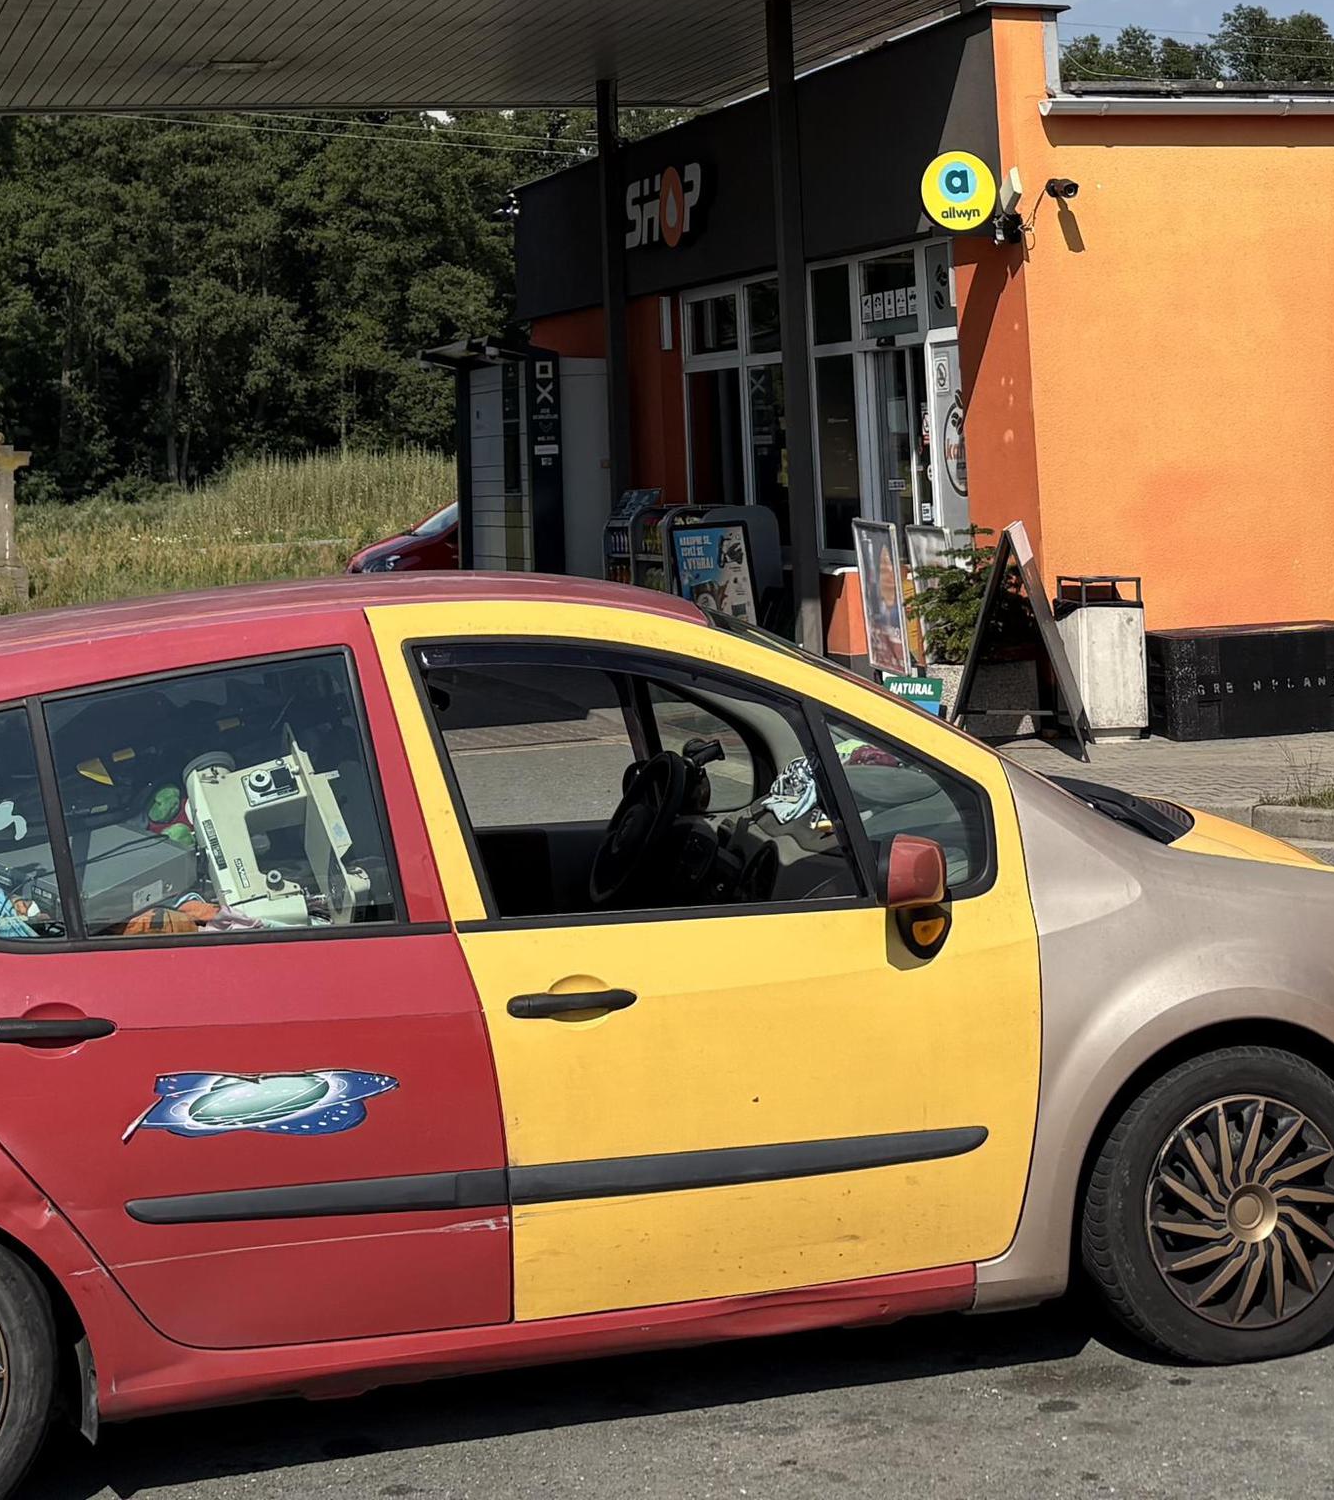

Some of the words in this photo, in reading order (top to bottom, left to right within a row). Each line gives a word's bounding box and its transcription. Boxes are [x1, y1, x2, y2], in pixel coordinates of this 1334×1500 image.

[625, 162, 701, 249] SHOP
[941, 207, 981, 222] allwyn
[889, 682, 934, 696] NATURAL
